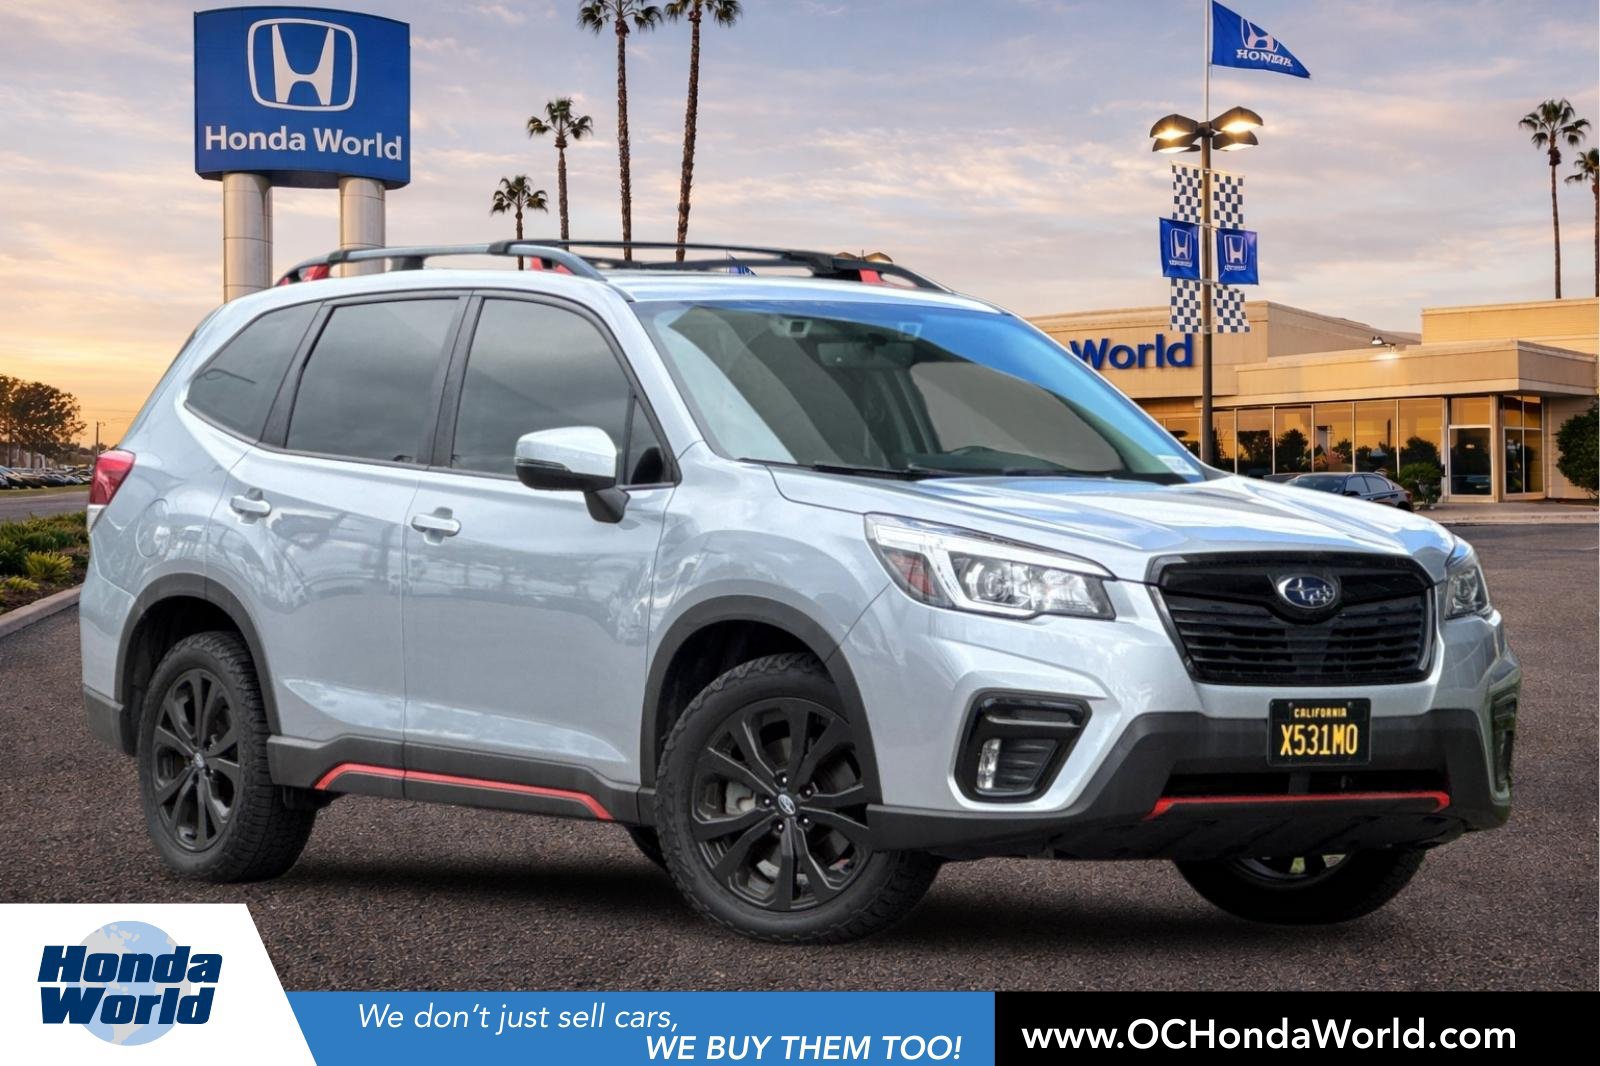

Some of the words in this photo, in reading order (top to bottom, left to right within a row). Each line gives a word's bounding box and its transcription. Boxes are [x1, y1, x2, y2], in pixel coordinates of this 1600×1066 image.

[205, 125, 306, 151] Honda
[313, 127, 402, 161] World
[1070, 333, 1193, 370] World
[1294, 708, 1347, 718] CALIFORNIA
